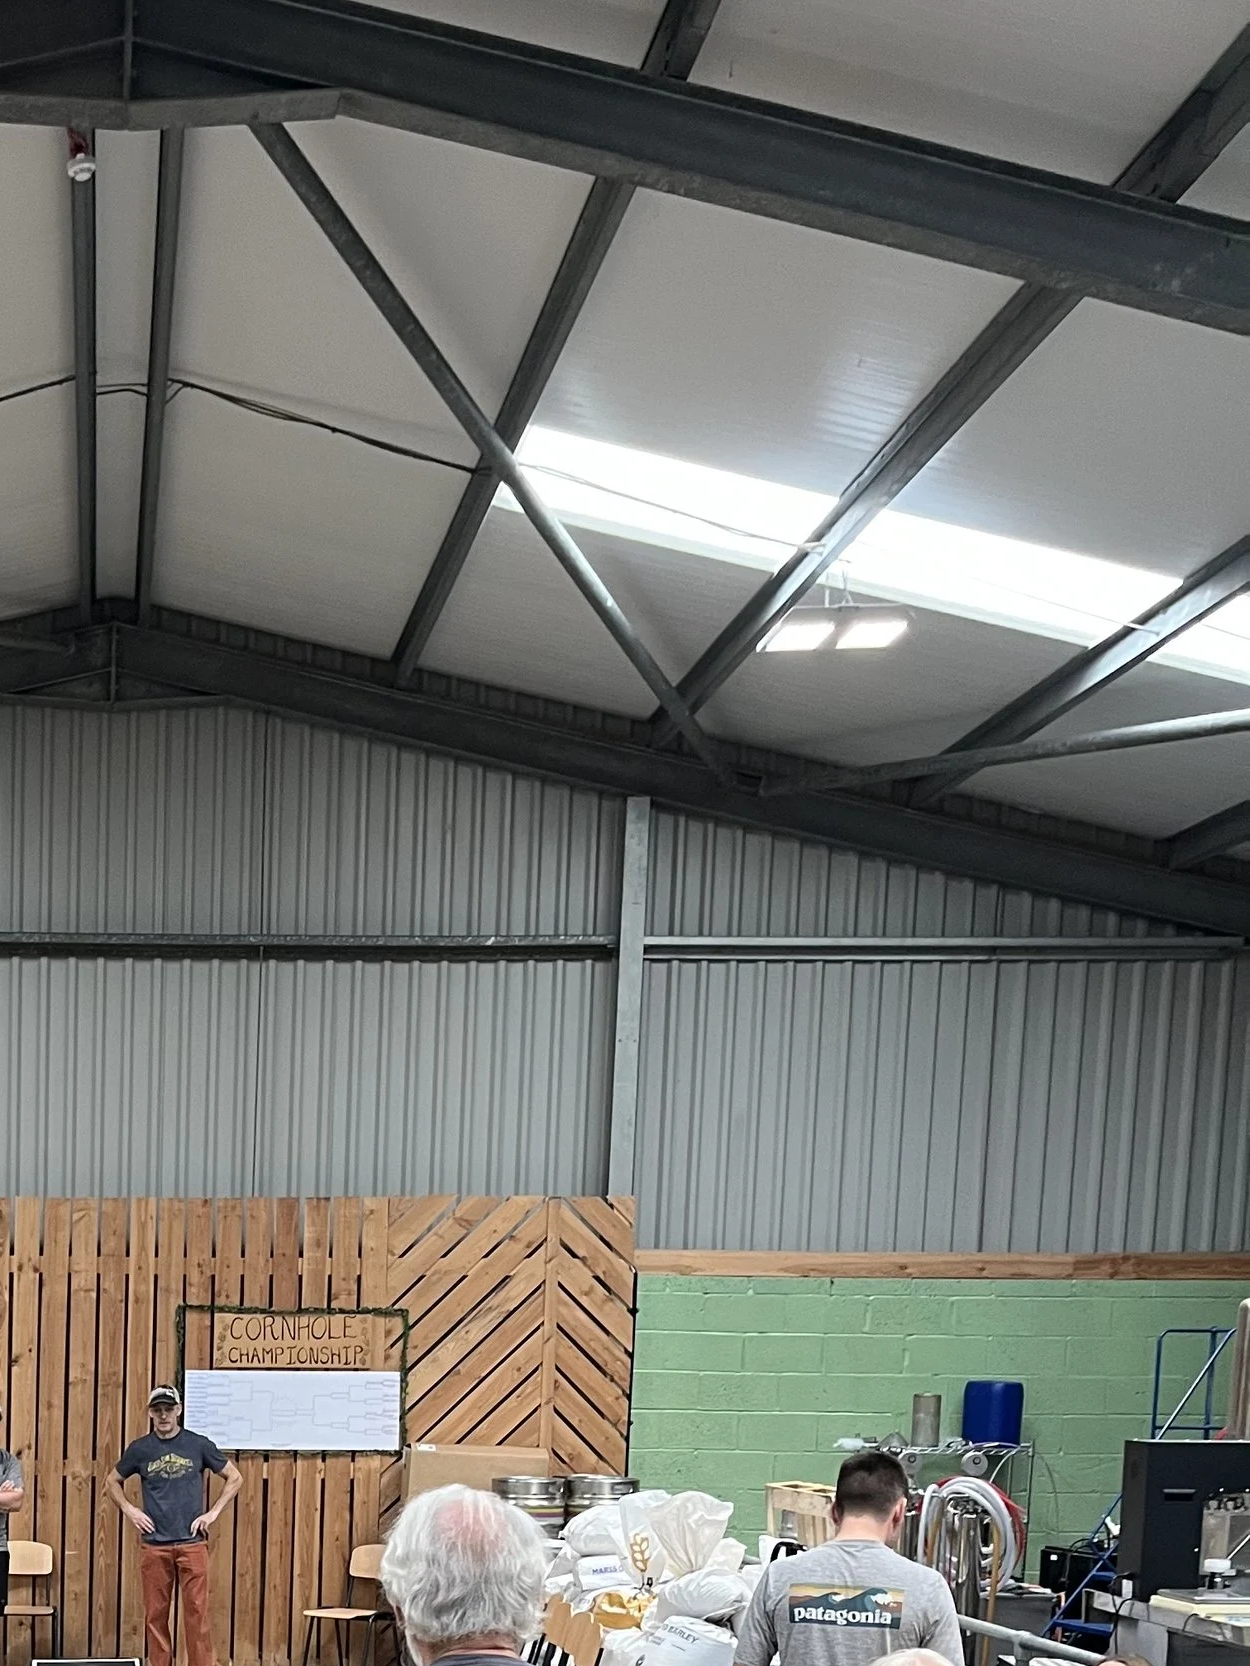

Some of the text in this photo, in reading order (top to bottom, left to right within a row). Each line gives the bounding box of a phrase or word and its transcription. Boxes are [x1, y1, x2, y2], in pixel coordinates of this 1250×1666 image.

[230, 1315, 357, 1341] CORNHOLE
[228, 1345, 364, 1365] CHAMPIONSHIP
[793, 1606, 892, 1625] patagonia
[668, 1626, 699, 1644] BARLEY
